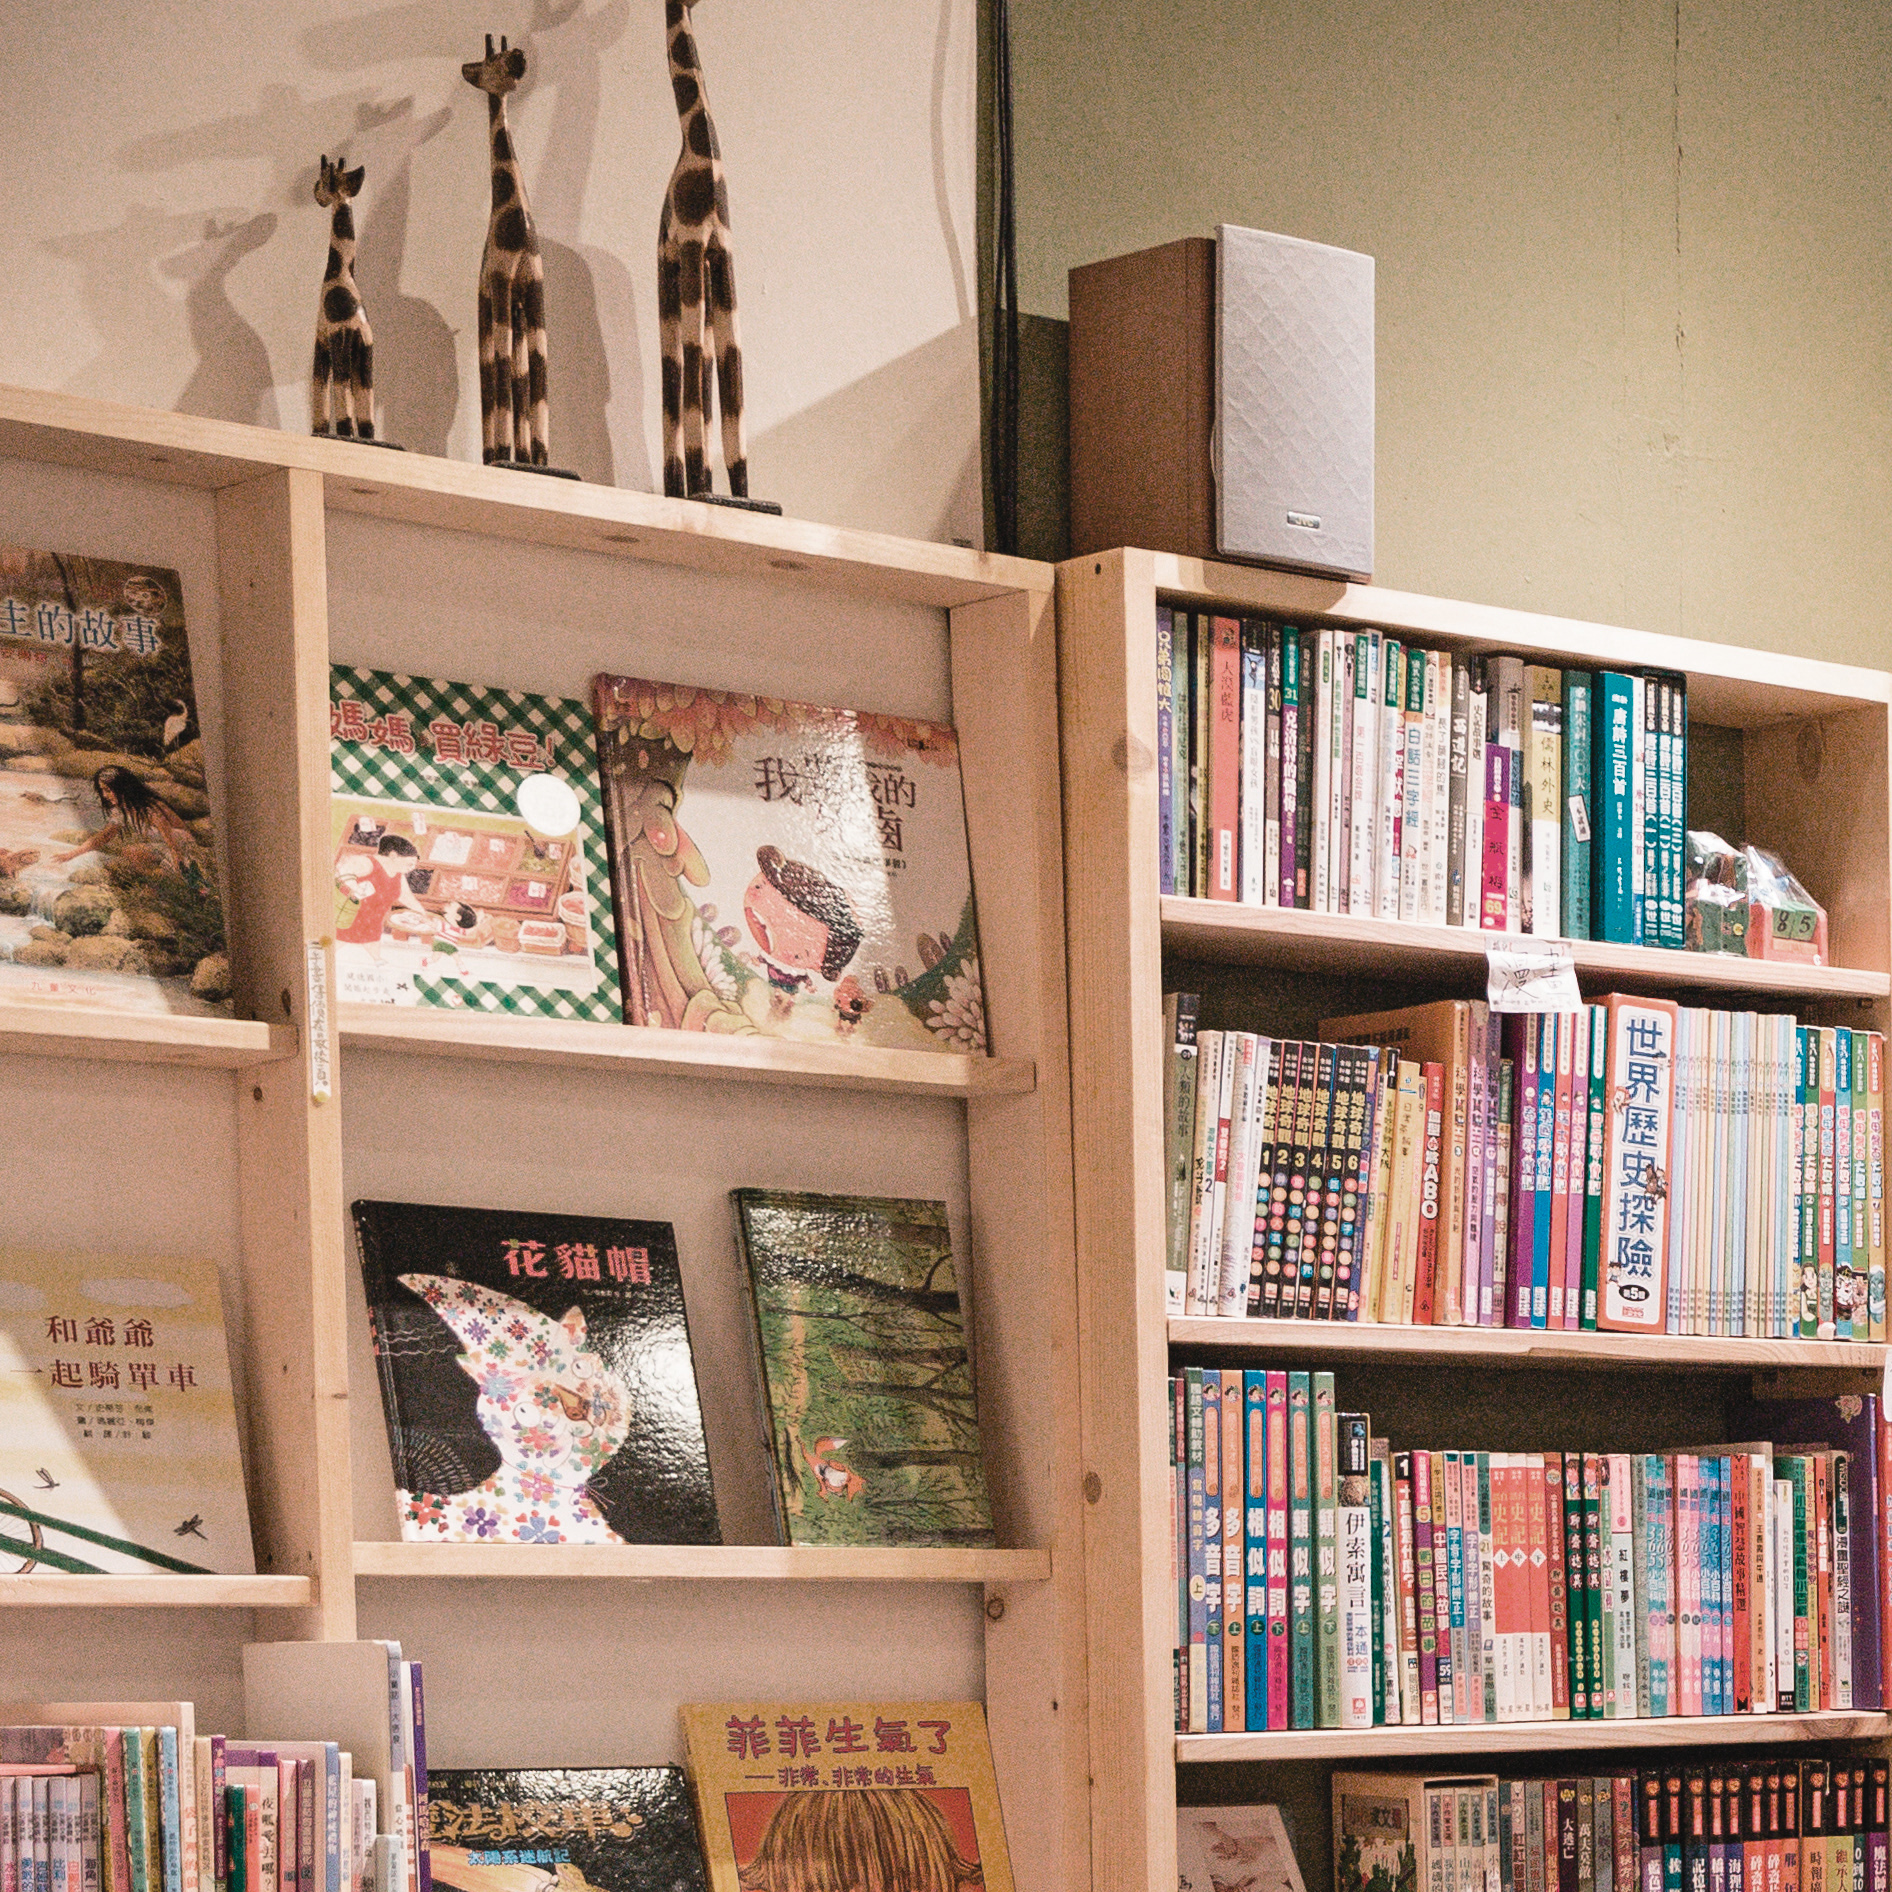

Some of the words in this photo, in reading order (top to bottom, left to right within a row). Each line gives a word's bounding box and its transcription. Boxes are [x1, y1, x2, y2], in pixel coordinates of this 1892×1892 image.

[1540, 735, 1555, 815] 儒林外史
[1611, 708, 1629, 797] 唐詩三百首
[1780, 910, 1789, 933] 8
[1798, 910, 1811, 934] 5
[1616, 1015, 1664, 1279] 世界歷史探險
[45, 1314, 155, 1348] 和爺爺
[10, 1358, 198, 1393] 一起騎單車
[1205, 1506, 1222, 1618] 多音字
[1225, 1506, 1242, 1618] 多音字
[1247, 1507, 1265, 1616] 相似詞
[1268, 1508, 1287, 1618] 相似詞
[1293, 1507, 1311, 1615] 類似字
[1319, 1508, 1338, 1616] 類似字
[1344, 1511, 1366, 1608] 伊索寓言
[1617, 1547, 1630, 1606] 紅樓夢
[724, 1712, 952, 1760] 菲菲生氣了
[467, 1848, 571, 1866] 太陽系迷航記
[1562, 1817, 1575, 1860] 大逃亡
